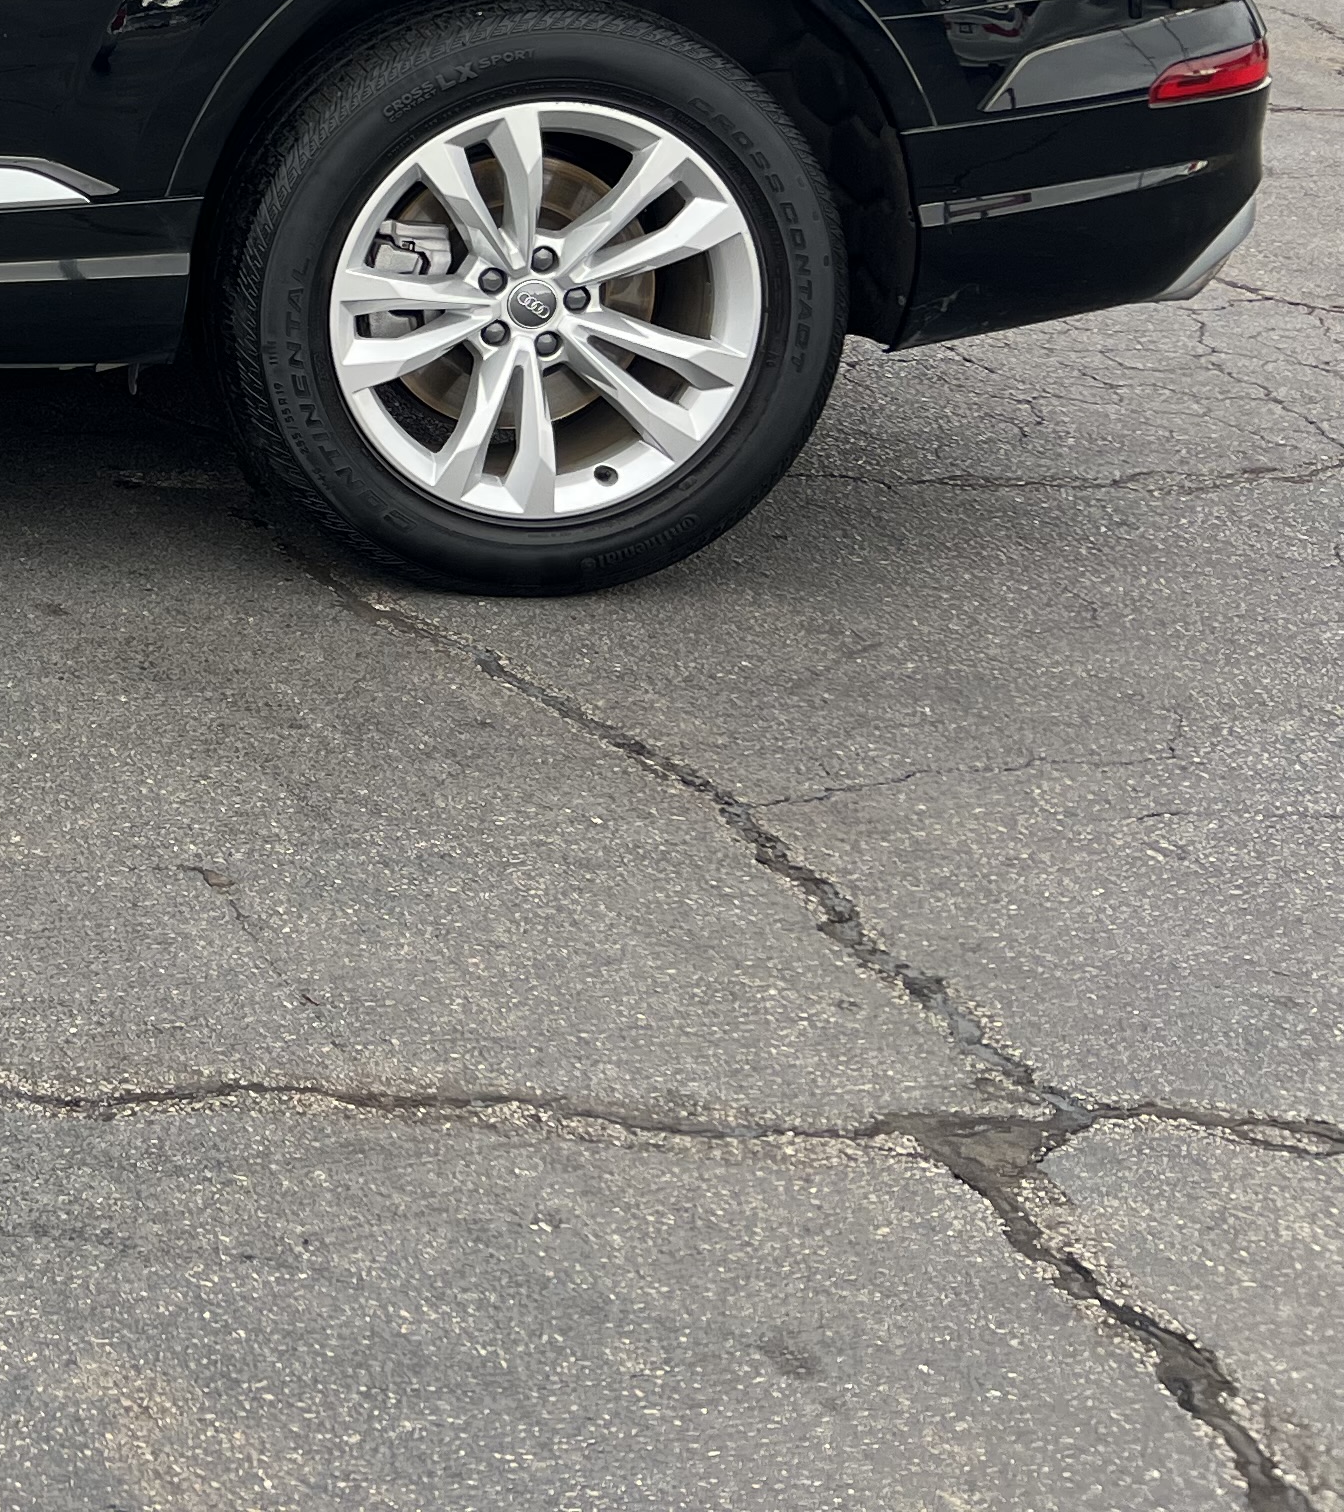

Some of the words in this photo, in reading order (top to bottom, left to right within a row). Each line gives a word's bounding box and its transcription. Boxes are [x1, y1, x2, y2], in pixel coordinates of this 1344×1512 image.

[435, 61, 480, 92] LX
[478, 47, 537, 70] SPORT
[284, 256, 418, 533] CONTINENTAL
